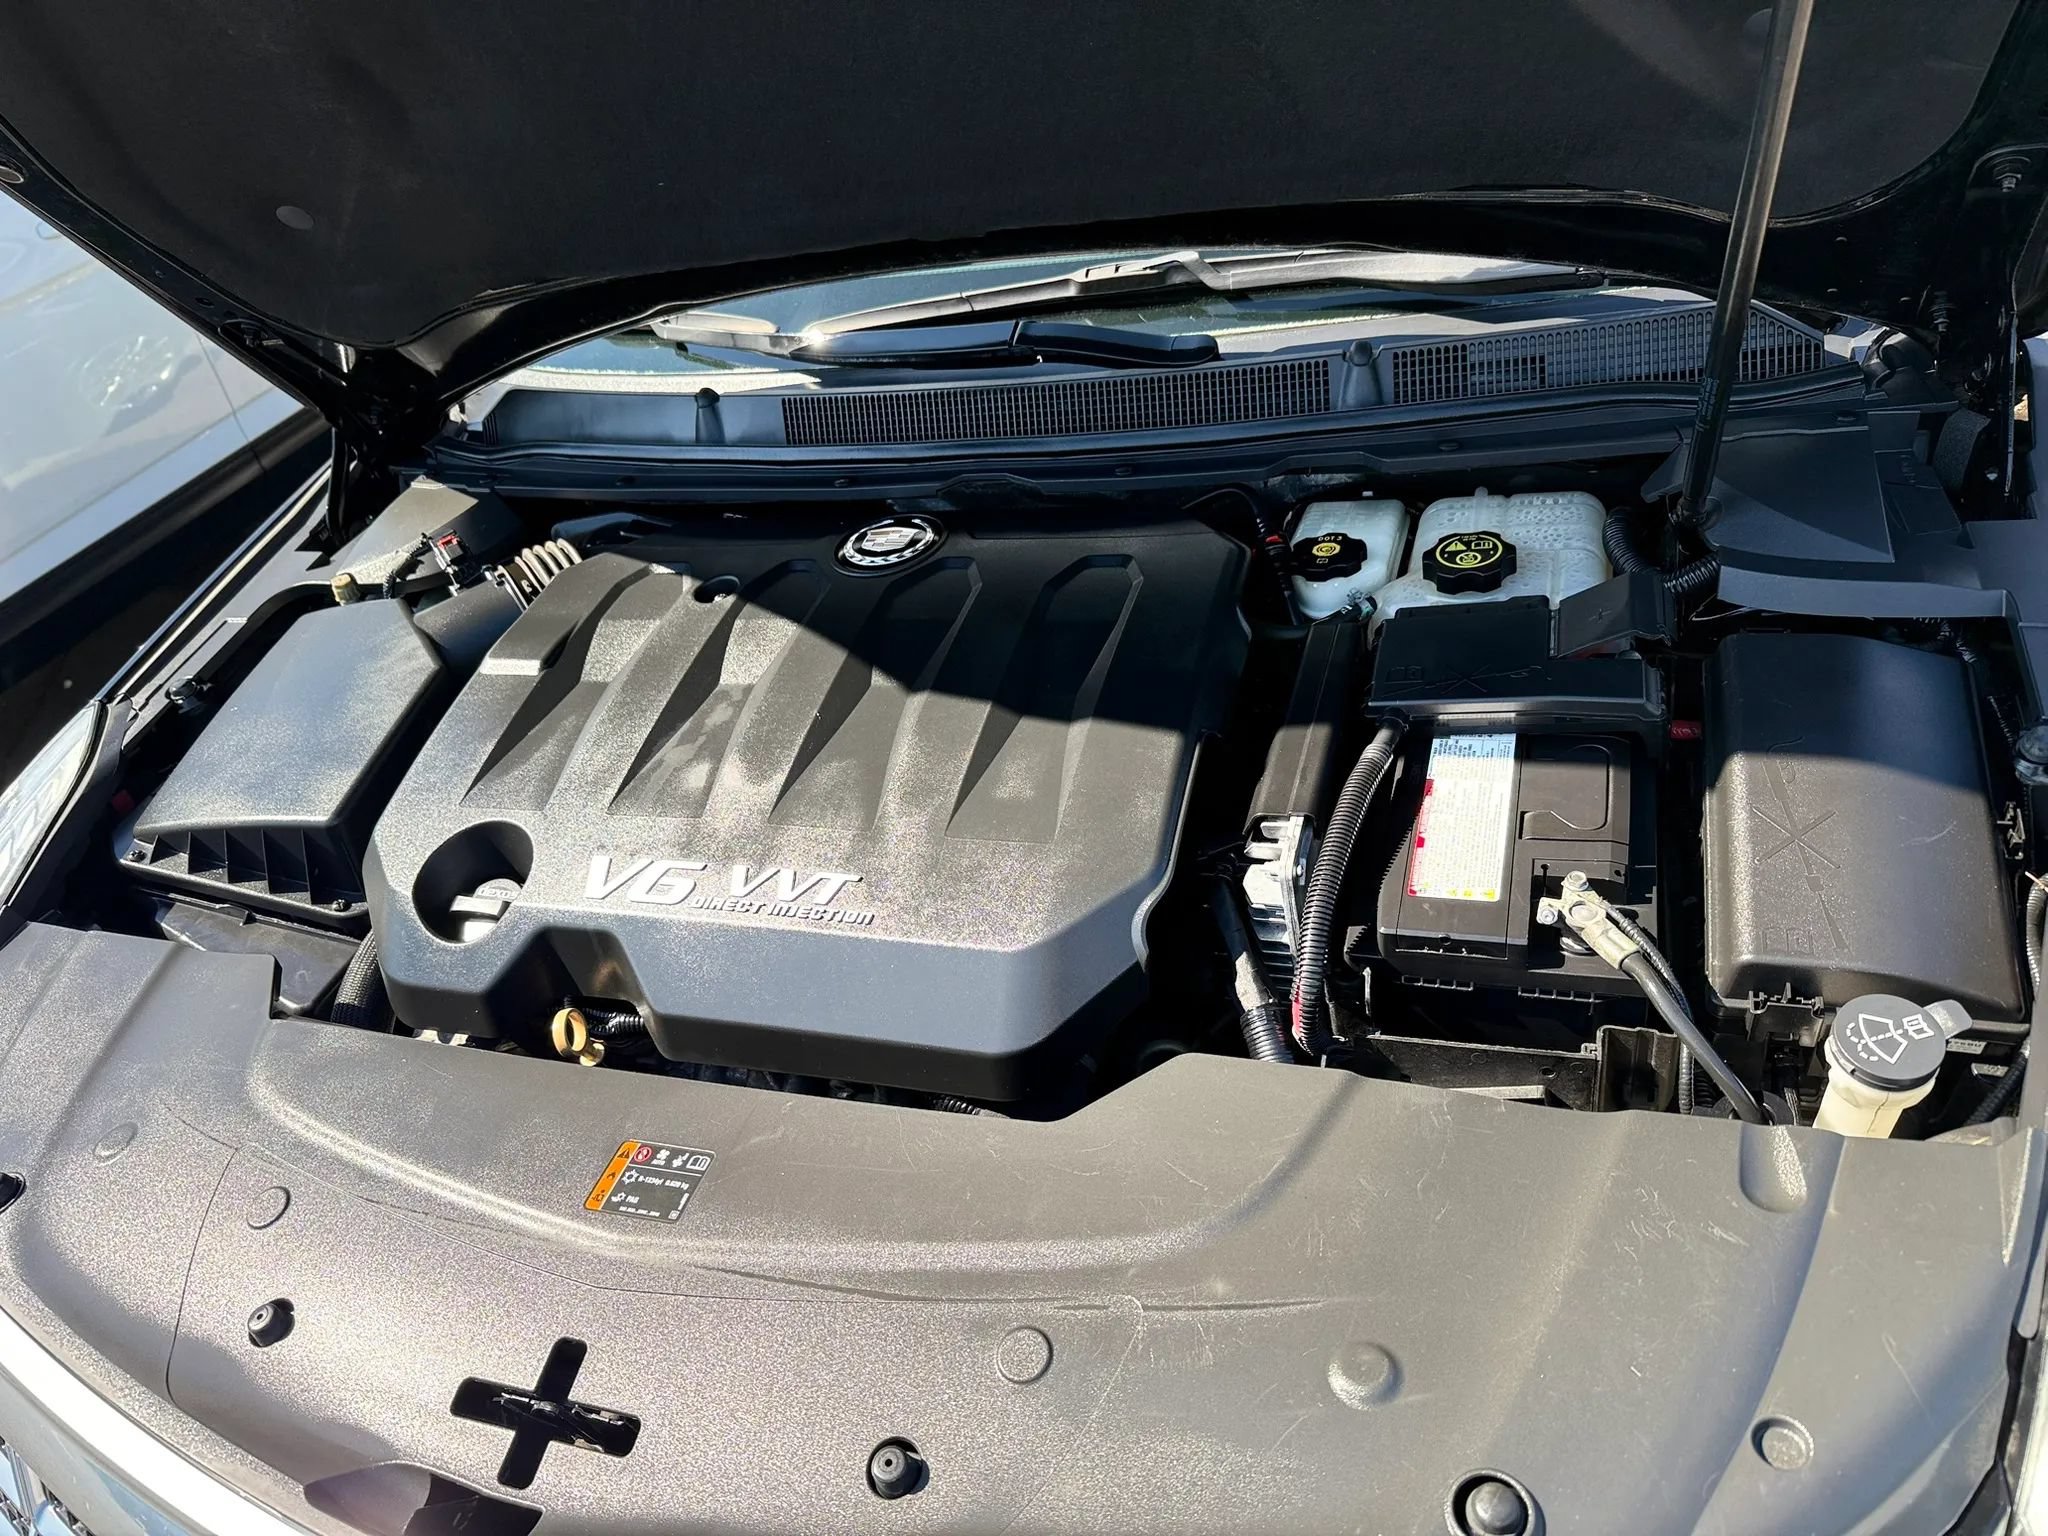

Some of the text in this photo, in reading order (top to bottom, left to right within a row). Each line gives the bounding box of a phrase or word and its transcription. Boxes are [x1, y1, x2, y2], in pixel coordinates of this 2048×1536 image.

[585, 855, 863, 905] V6 VVT
[688, 896, 875, 926] DIRECT INJECTION
